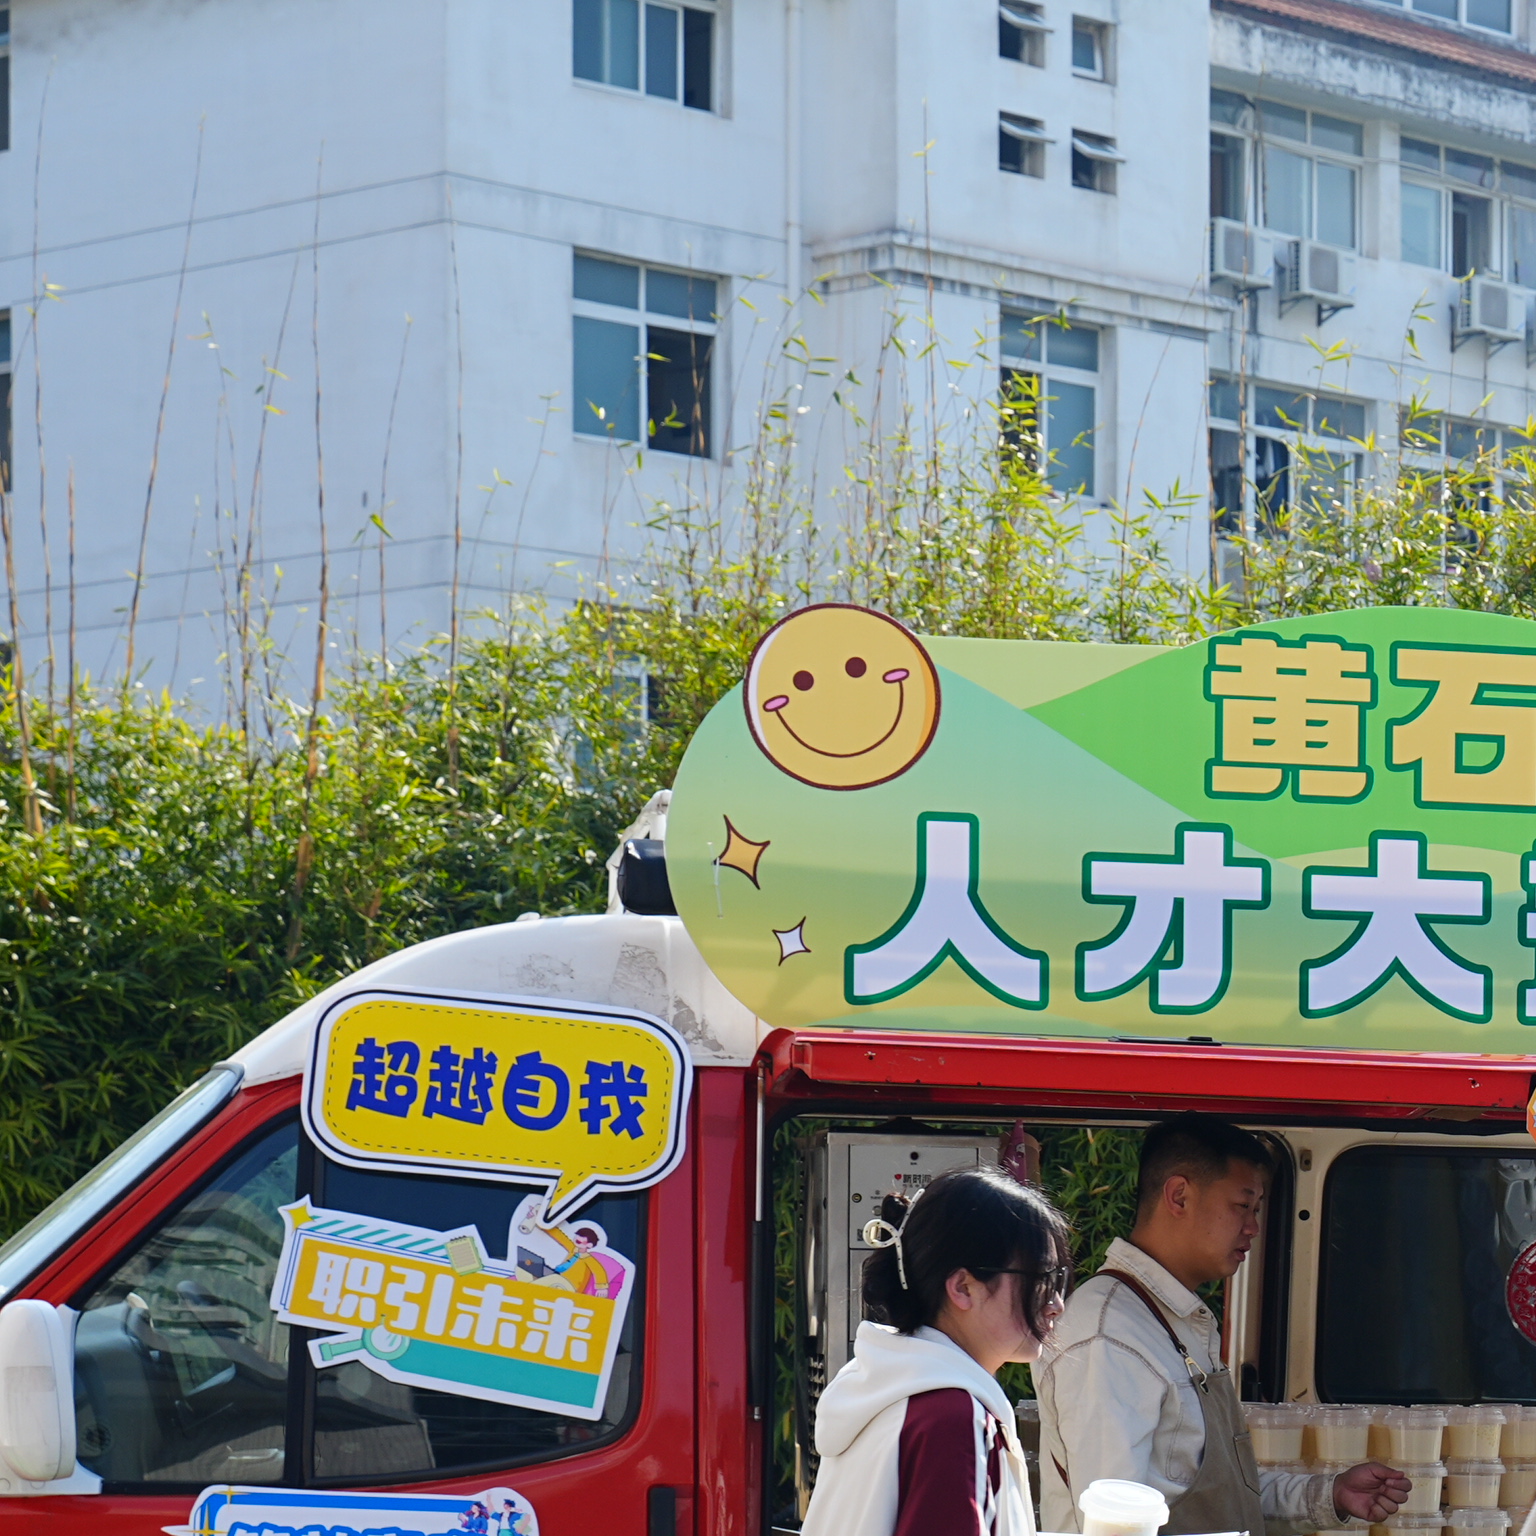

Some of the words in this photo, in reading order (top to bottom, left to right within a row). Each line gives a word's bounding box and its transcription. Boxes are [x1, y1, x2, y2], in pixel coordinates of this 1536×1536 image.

[345, 1036, 648, 1139] 超越自我
[308, 1250, 592, 1362] 职引未来
